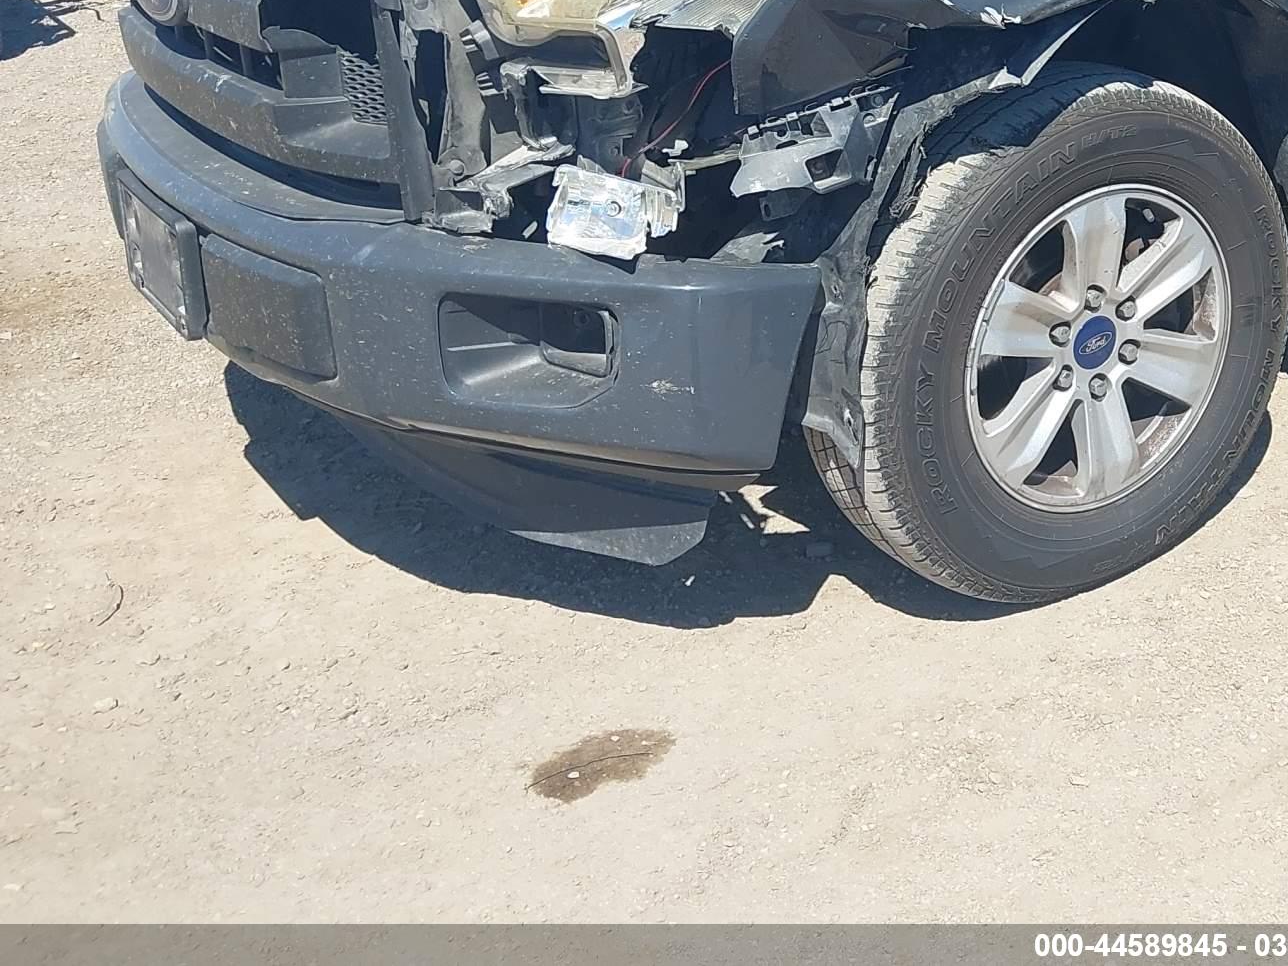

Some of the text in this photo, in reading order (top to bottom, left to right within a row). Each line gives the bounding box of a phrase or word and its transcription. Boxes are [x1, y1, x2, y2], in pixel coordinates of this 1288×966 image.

[922, 141, 1078, 353] MOUNTAIN
[1253, 204, 1283, 333] ROCKY
[915, 361, 959, 515] ROCKY
